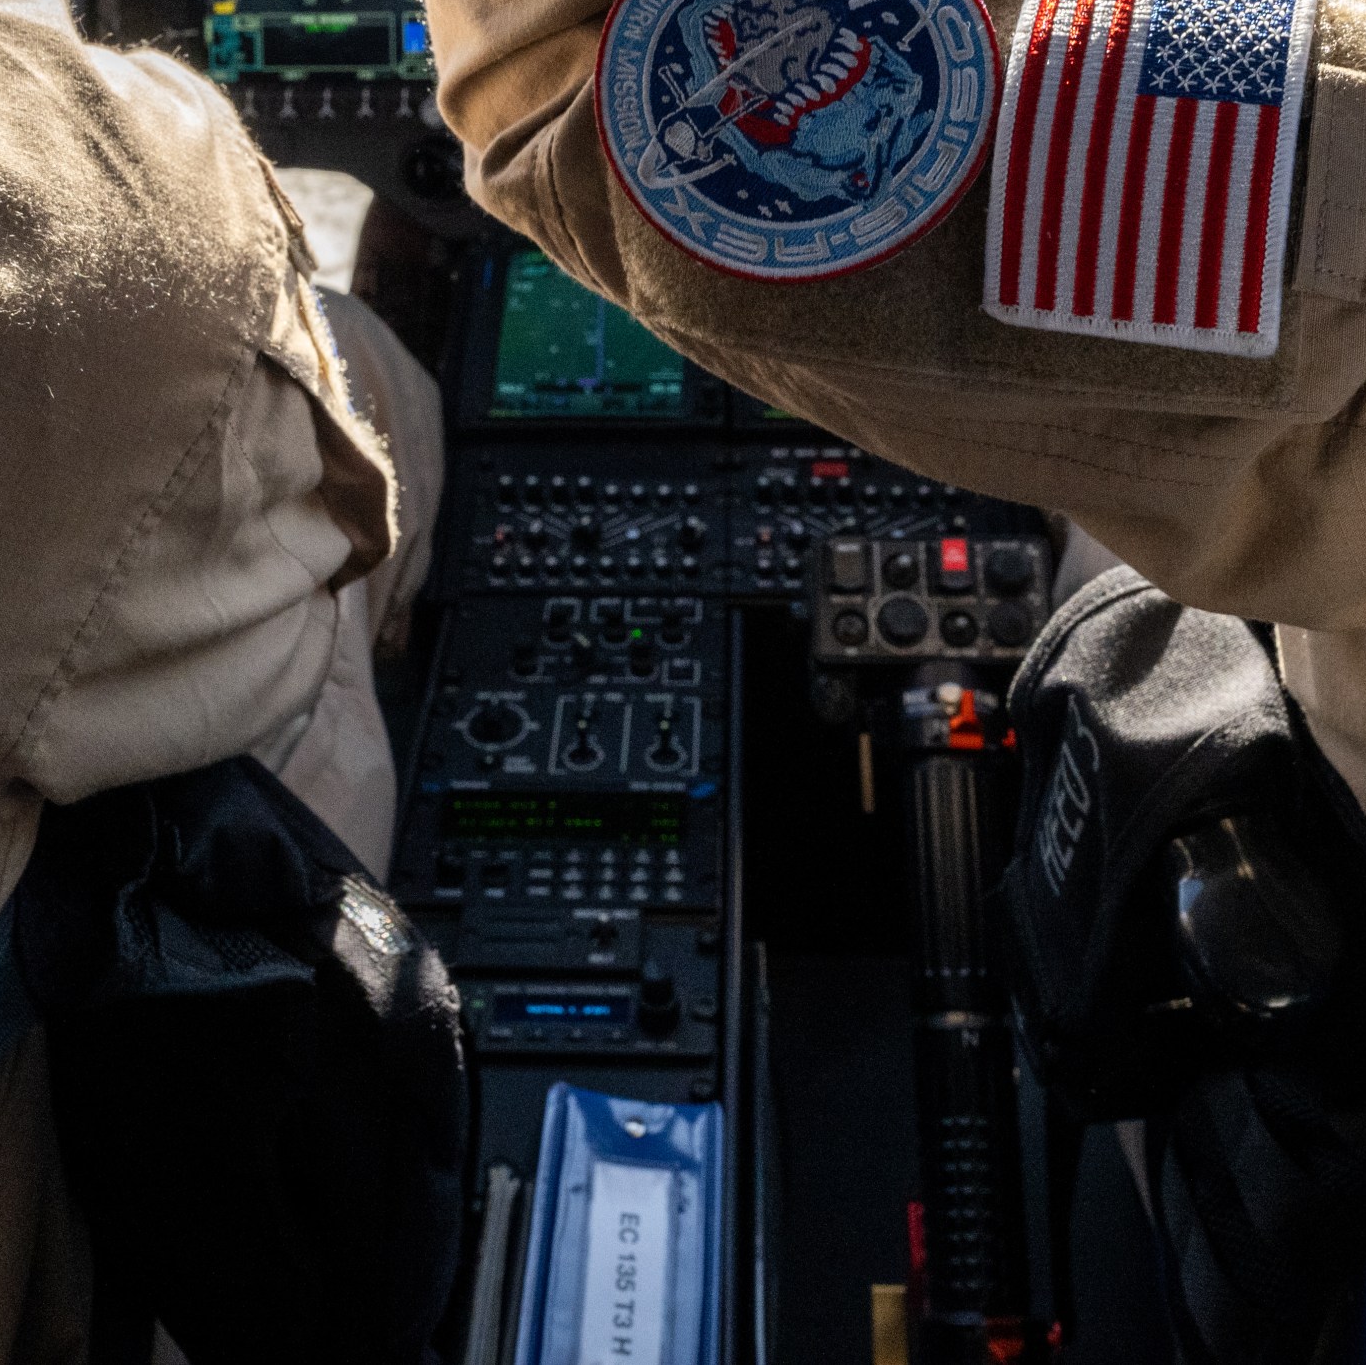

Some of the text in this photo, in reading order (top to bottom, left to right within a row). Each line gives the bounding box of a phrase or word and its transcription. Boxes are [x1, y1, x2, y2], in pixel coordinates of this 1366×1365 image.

[614, 48, 647, 151] MISSION
[658, 4, 980, 263] OSIRIS-REX
[611, 1211, 641, 1357] EC 135 T3 H
